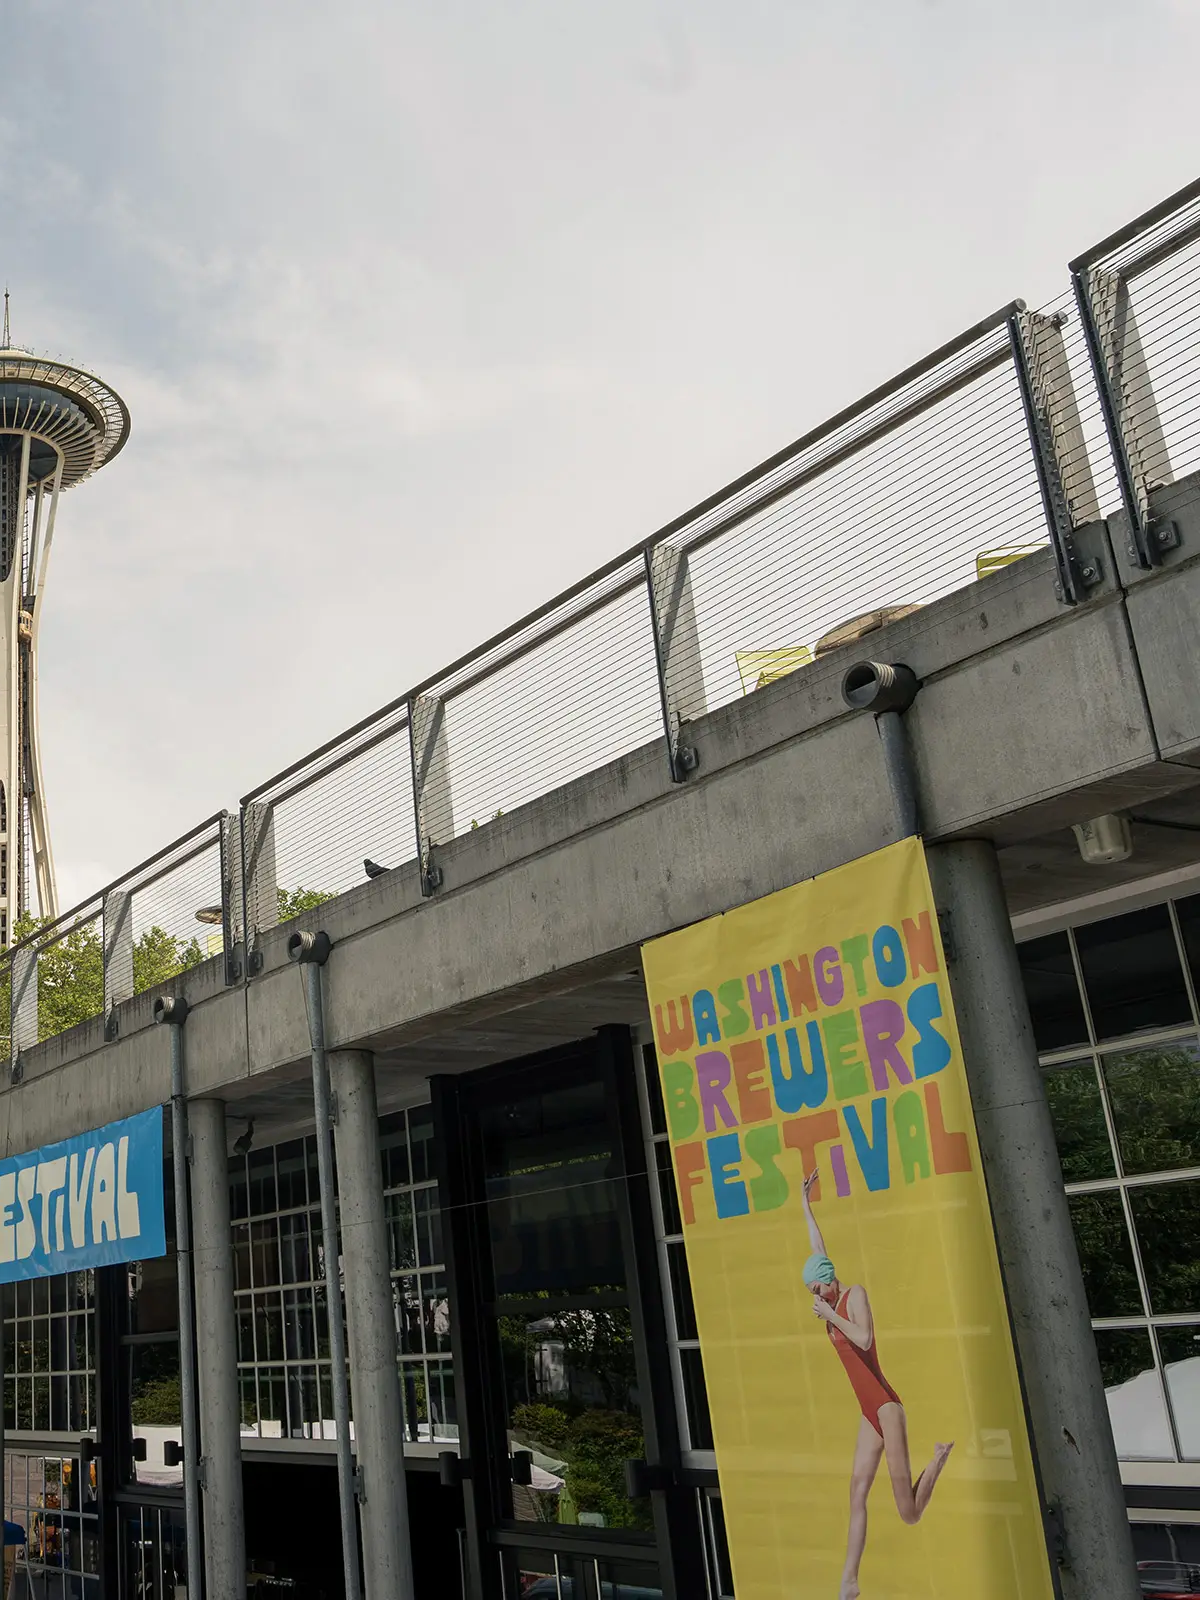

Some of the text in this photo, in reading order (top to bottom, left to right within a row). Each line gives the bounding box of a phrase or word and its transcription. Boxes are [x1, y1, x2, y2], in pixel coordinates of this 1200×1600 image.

[654, 910, 939, 1056] WASHINGTON
[663, 982, 952, 1141] BREWERS
[674, 1081, 972, 1225] FESTIVAL
